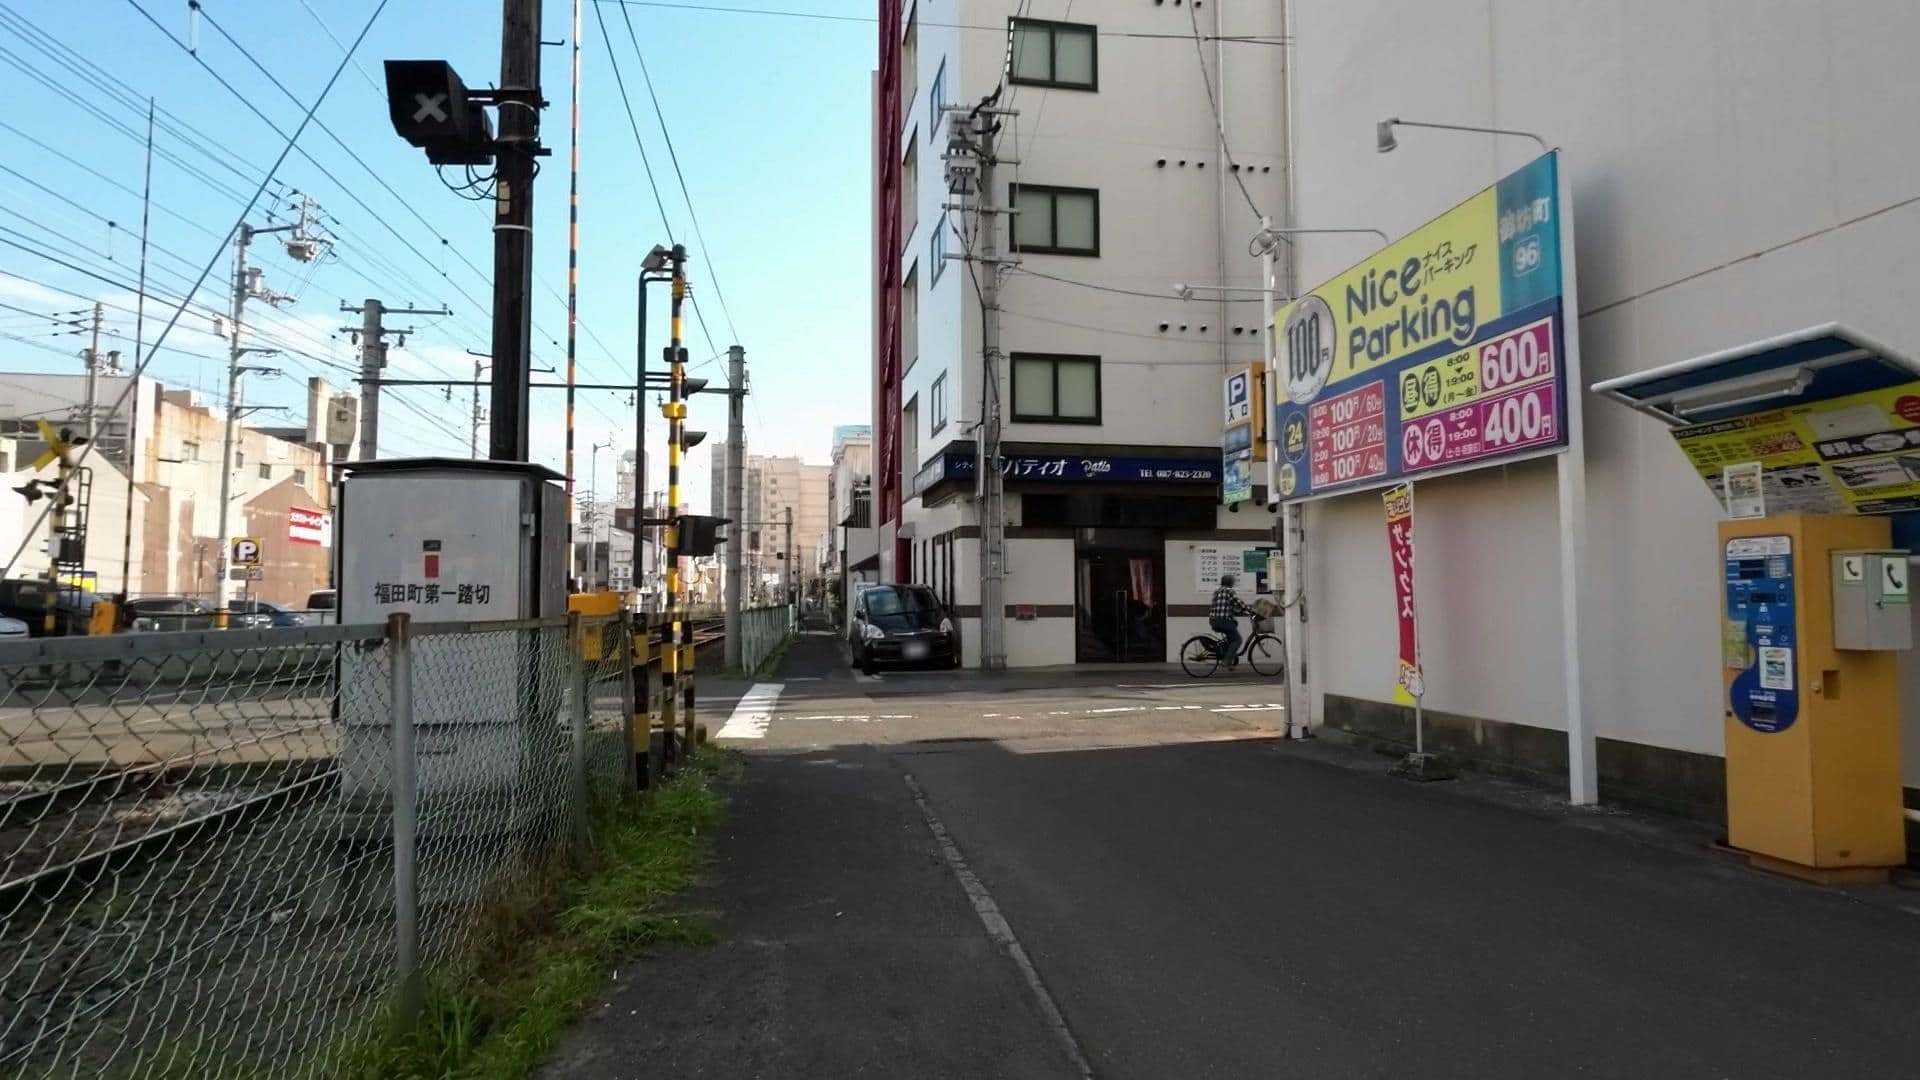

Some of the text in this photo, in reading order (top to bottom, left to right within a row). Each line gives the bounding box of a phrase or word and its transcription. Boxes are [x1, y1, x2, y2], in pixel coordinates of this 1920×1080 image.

[1423, 241, 1452, 268] ナイス
[1423, 244, 1477, 285] パーキング
[1516, 241, 1538, 270] 96
[1346, 257, 1421, 323] Nice
[1349, 286, 1474, 369] Parking
[1447, 352, 1470, 366] 8:00
[1482, 331, 1548, 389] 600円
[1446, 372, 1474, 387] 19:00
[1229, 404, 1248, 422] 入口
[1450, 408, 1473, 421] 8:00
[1485, 392, 1551, 445] 400円
[1288, 421, 1303, 445] 24
[1448, 428, 1477, 441] 19:00
[1003, 459, 1068, 476] パティオ
[1140, 469, 1153, 478] TEL
[238, 541, 258, 561] P
[374, 582, 491, 605] 福田町第一踏切
